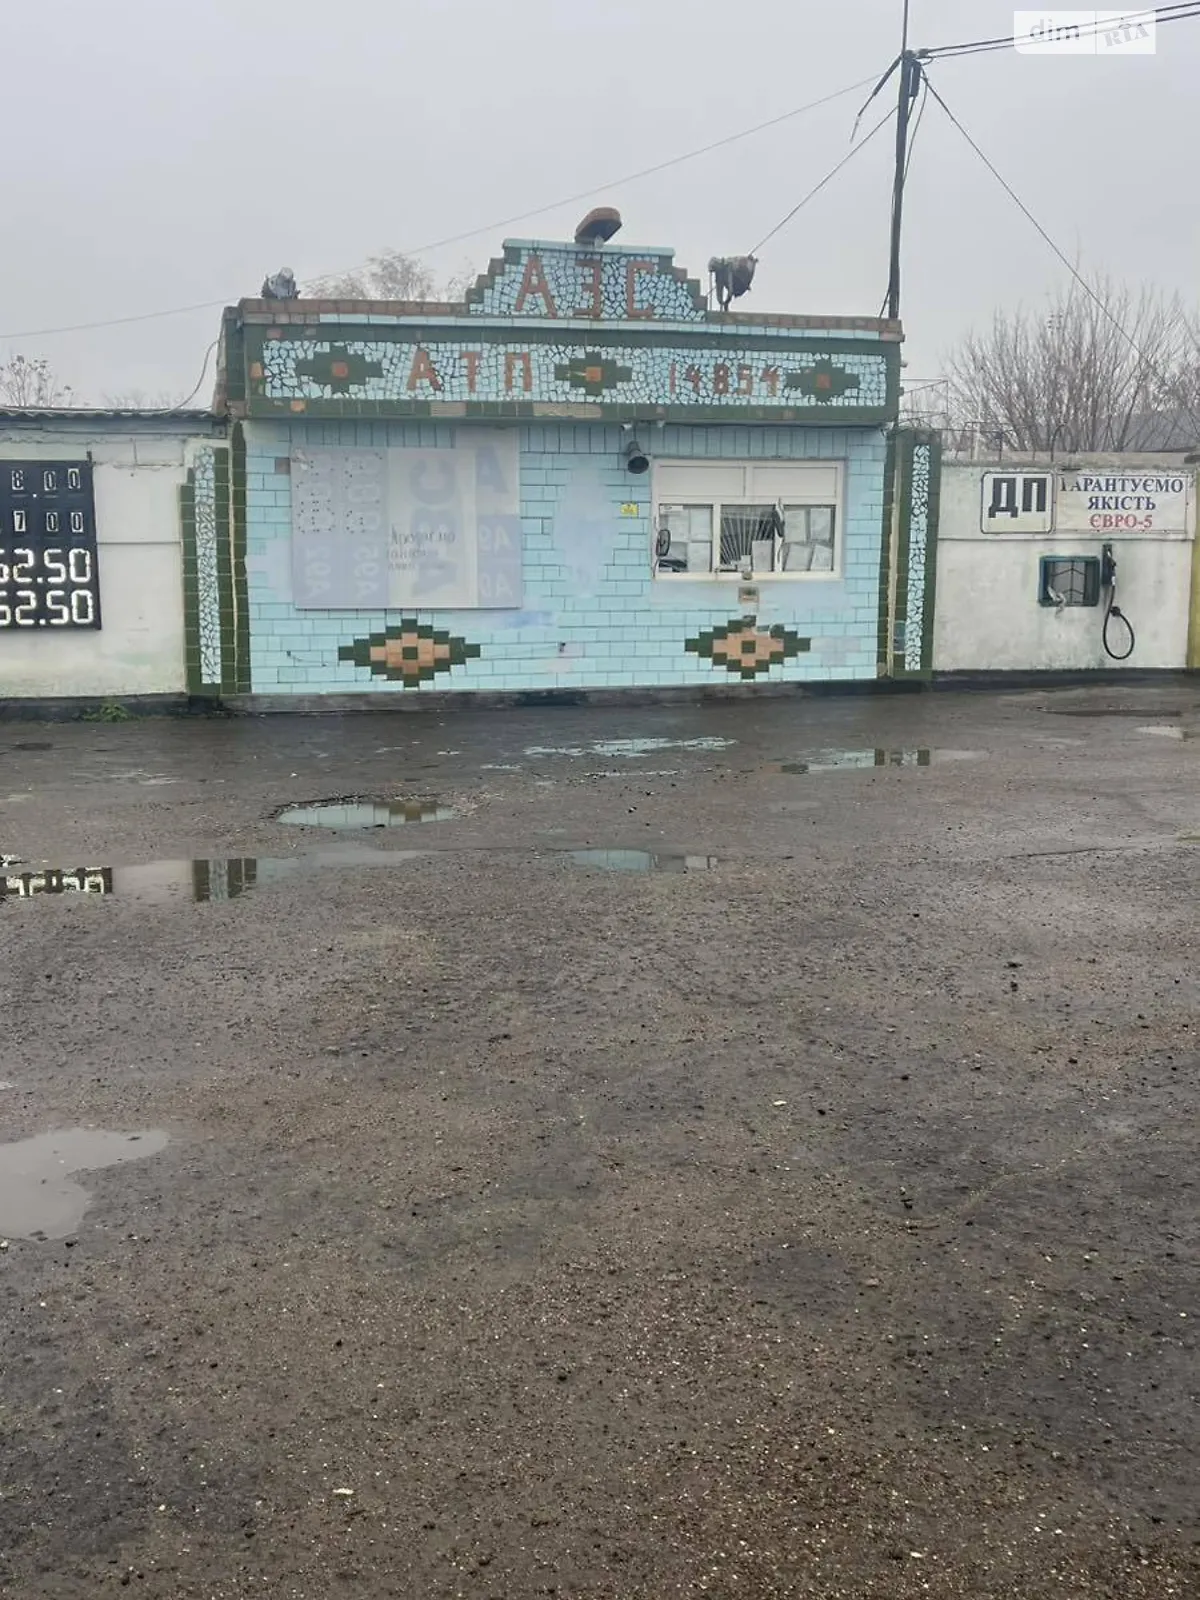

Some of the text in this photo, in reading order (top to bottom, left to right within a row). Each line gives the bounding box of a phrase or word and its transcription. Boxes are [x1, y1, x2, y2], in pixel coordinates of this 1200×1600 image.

[515, 254, 655, 320] АЗС
[406, 349, 533, 394] АТП
[988, 478, 1047, 518] ДП
[1087, 496, 1157, 511] ЯКІСТЬ
[1090, 513, 1153, 528] ЄВРО-5
